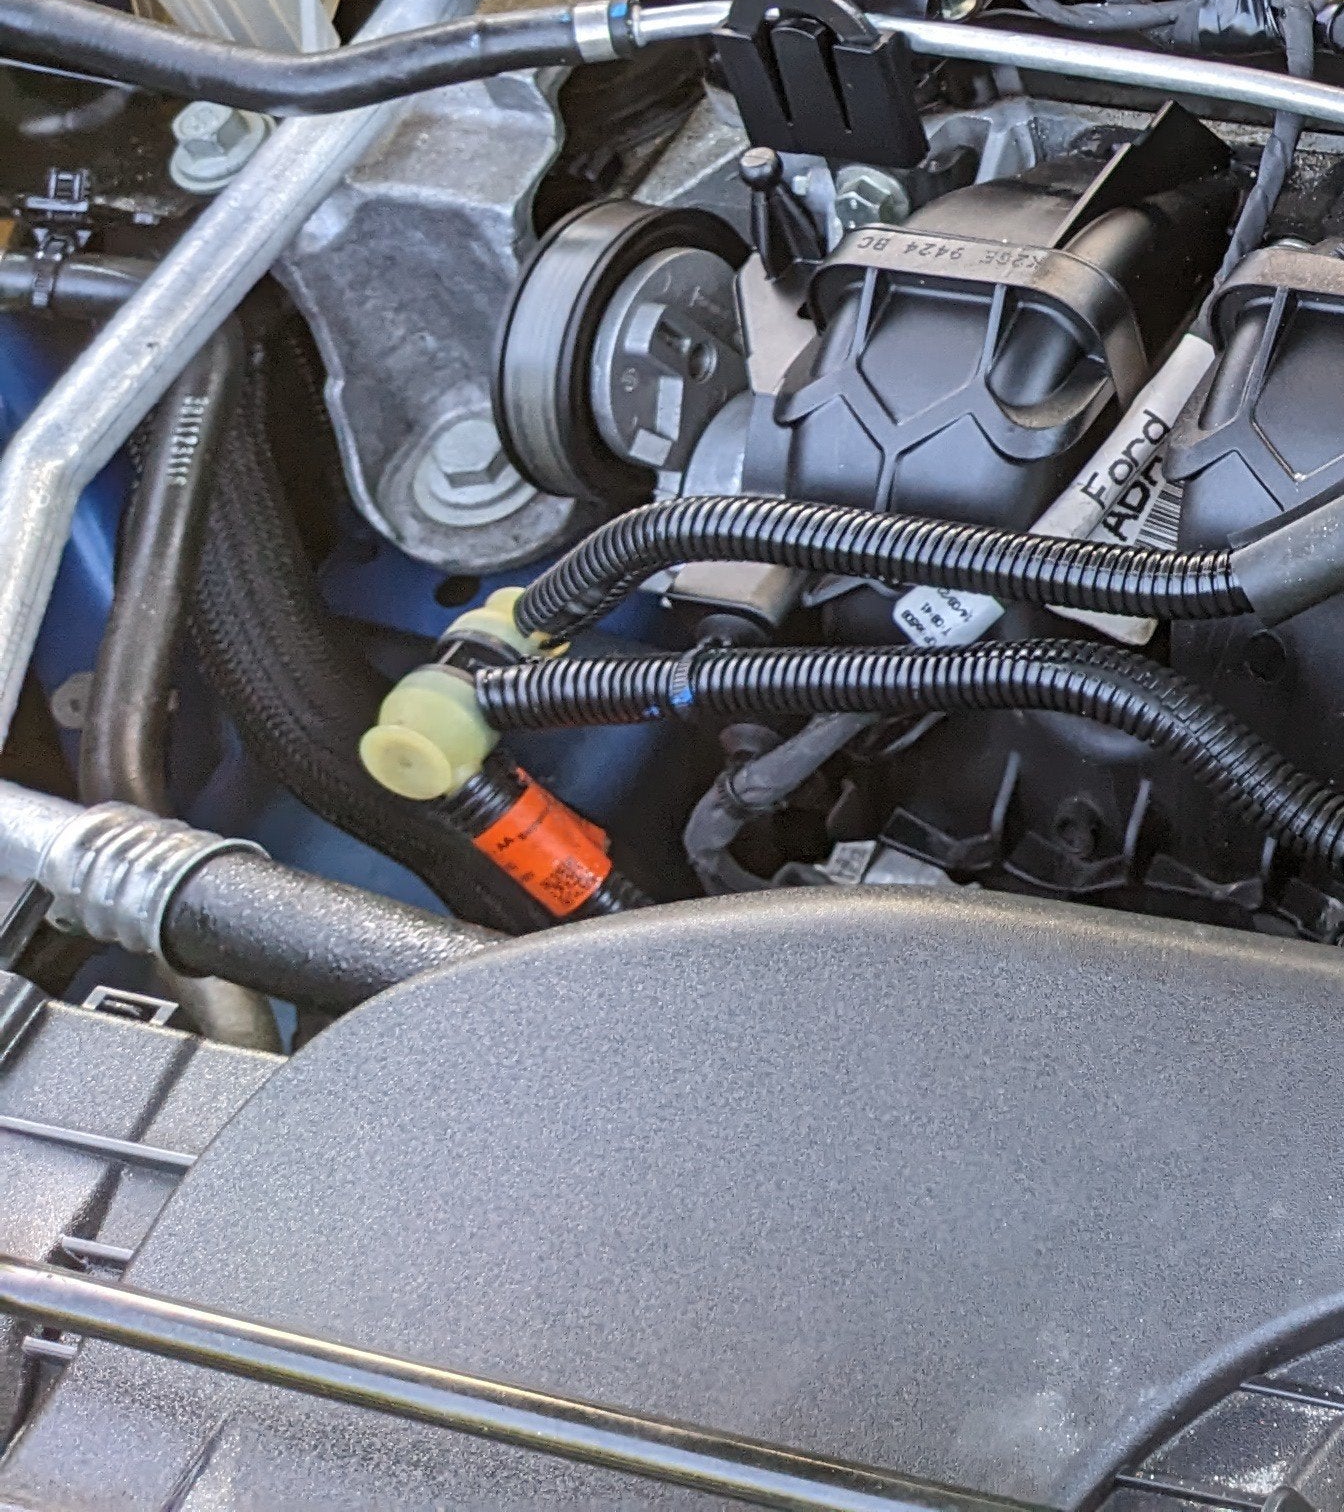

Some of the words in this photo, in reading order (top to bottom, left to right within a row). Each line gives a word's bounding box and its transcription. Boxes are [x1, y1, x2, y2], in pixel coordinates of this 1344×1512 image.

[857, 236, 891, 252] BC
[903, 241, 966, 261] 9424
[1081, 408, 1171, 511] Ford
